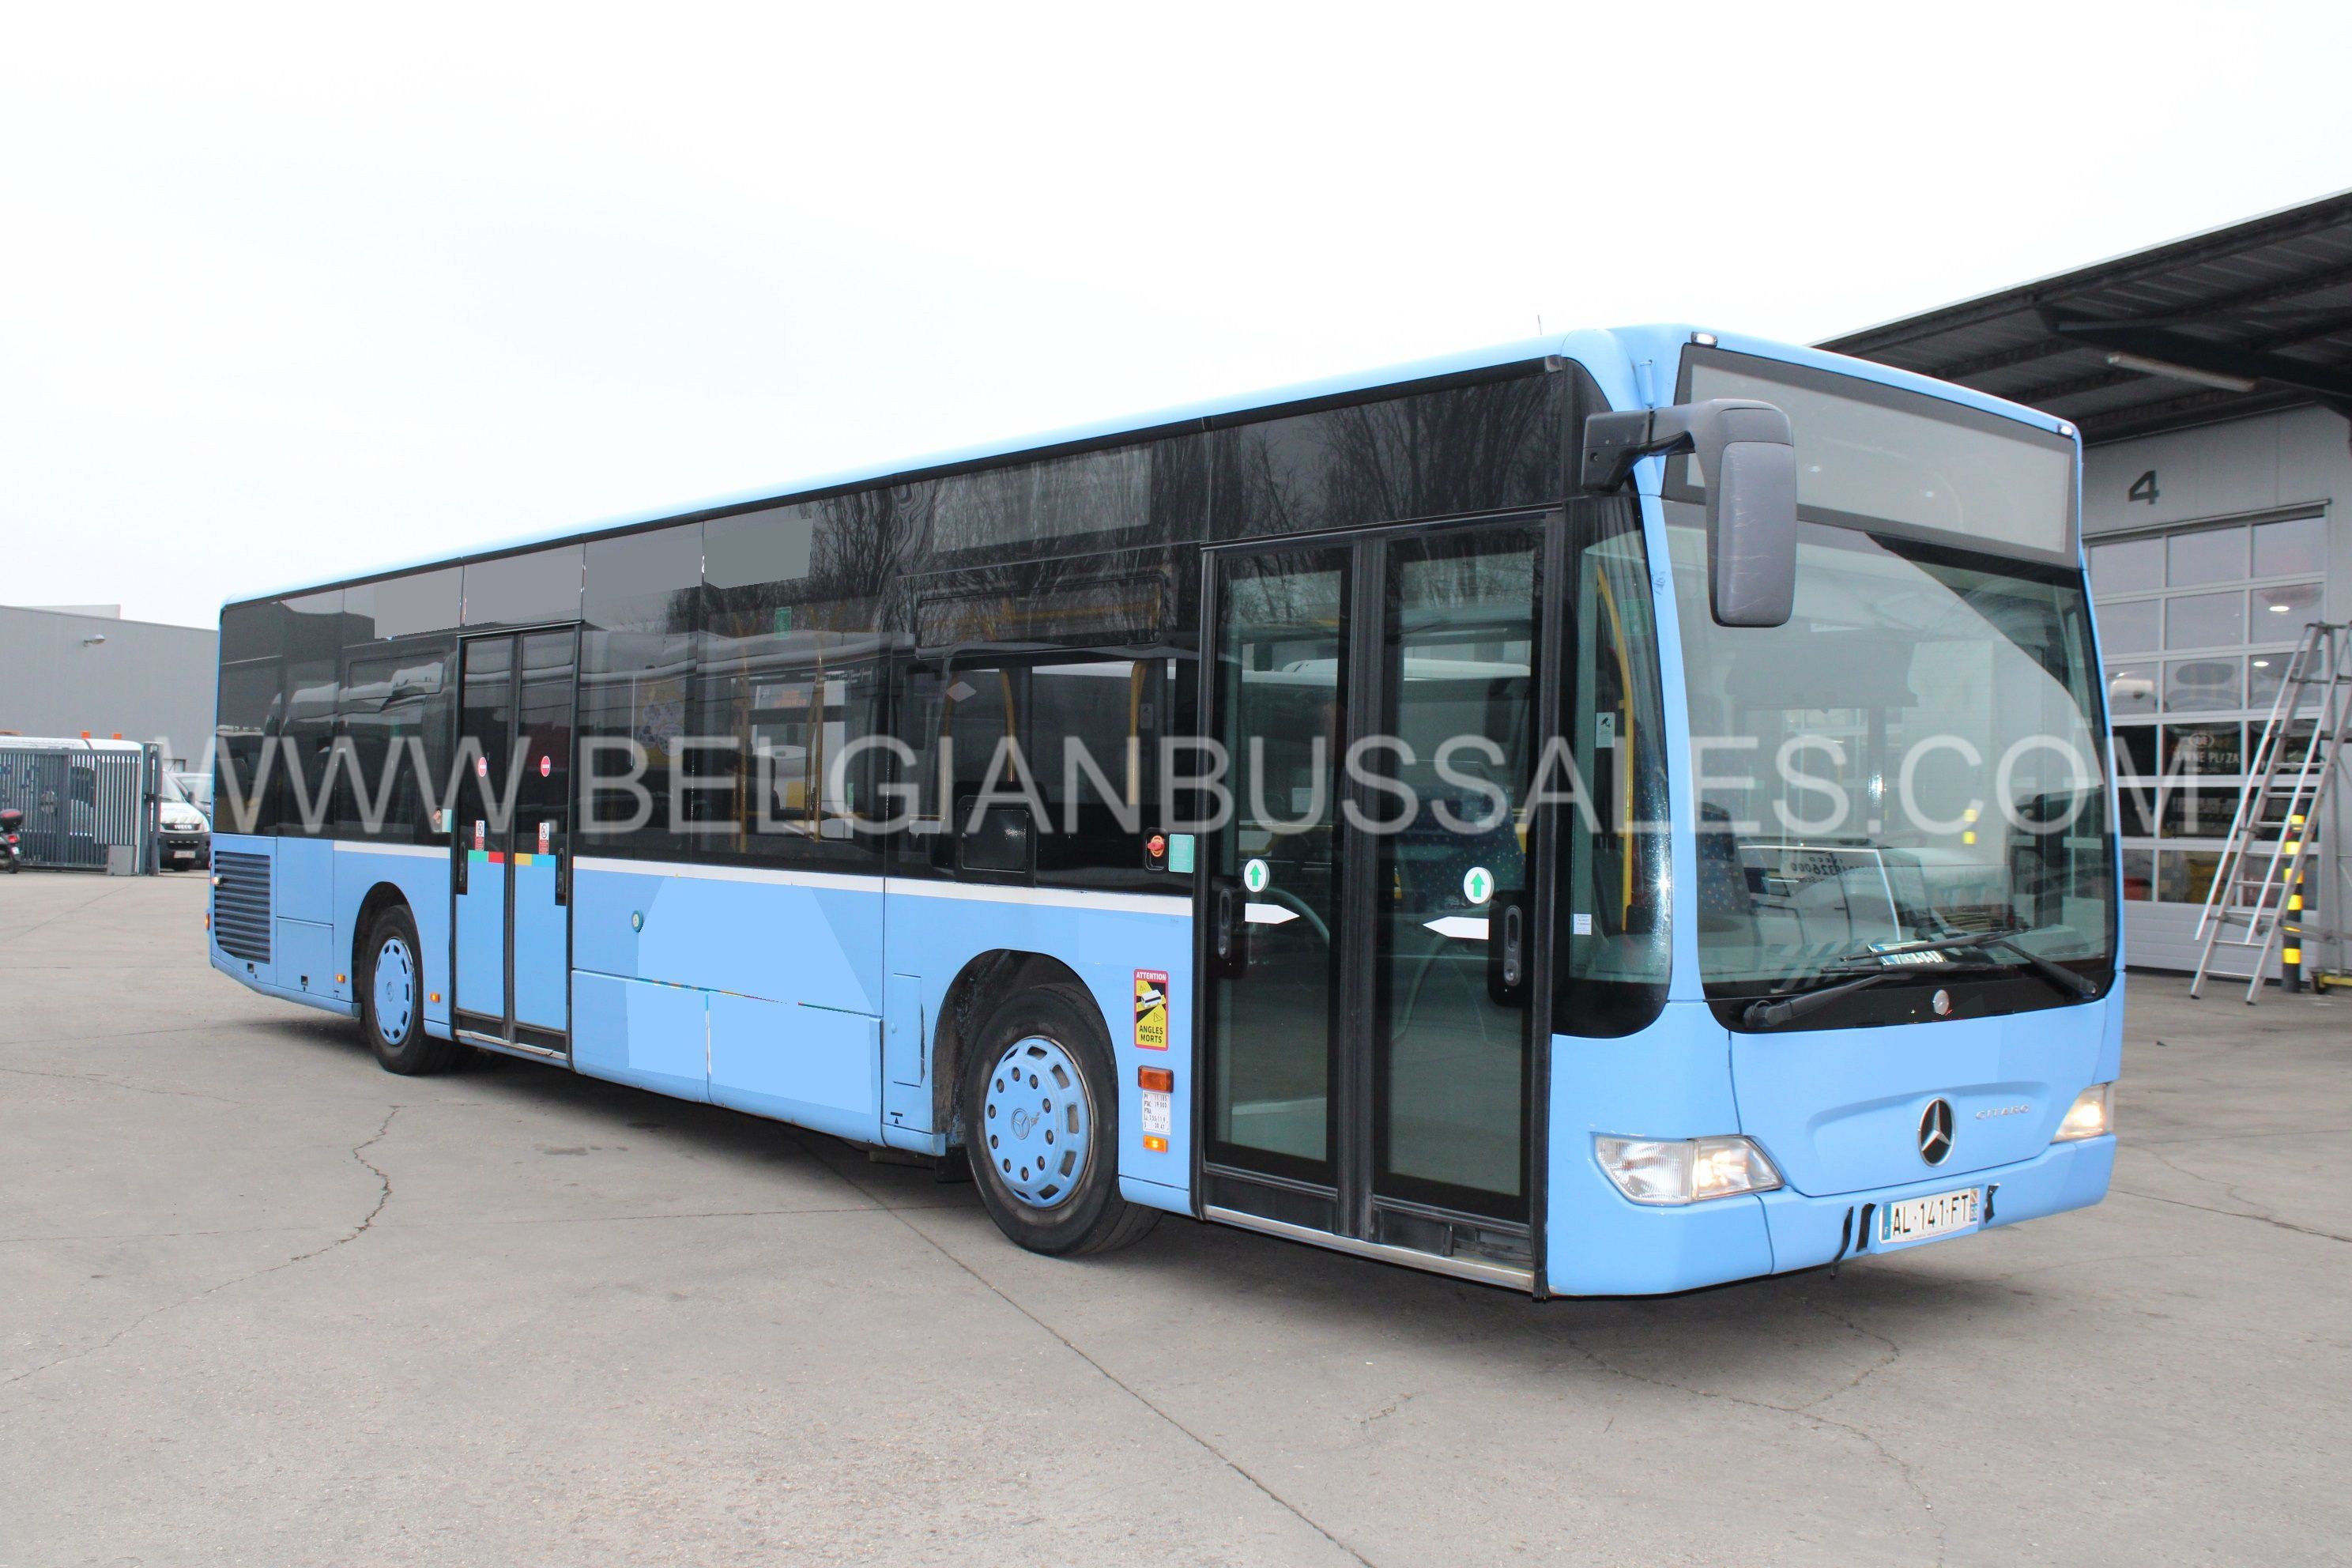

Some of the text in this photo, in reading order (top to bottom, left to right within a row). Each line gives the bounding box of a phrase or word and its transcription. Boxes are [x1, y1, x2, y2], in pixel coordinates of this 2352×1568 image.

[2128, 469, 2160, 505] 4
[1136, 971, 1167, 981] ATTENTION
[1139, 1025, 1163, 1035] ANGLES
[1140, 1034, 1163, 1043] MORTS
[1975, 1104, 2030, 1120] CITARO
